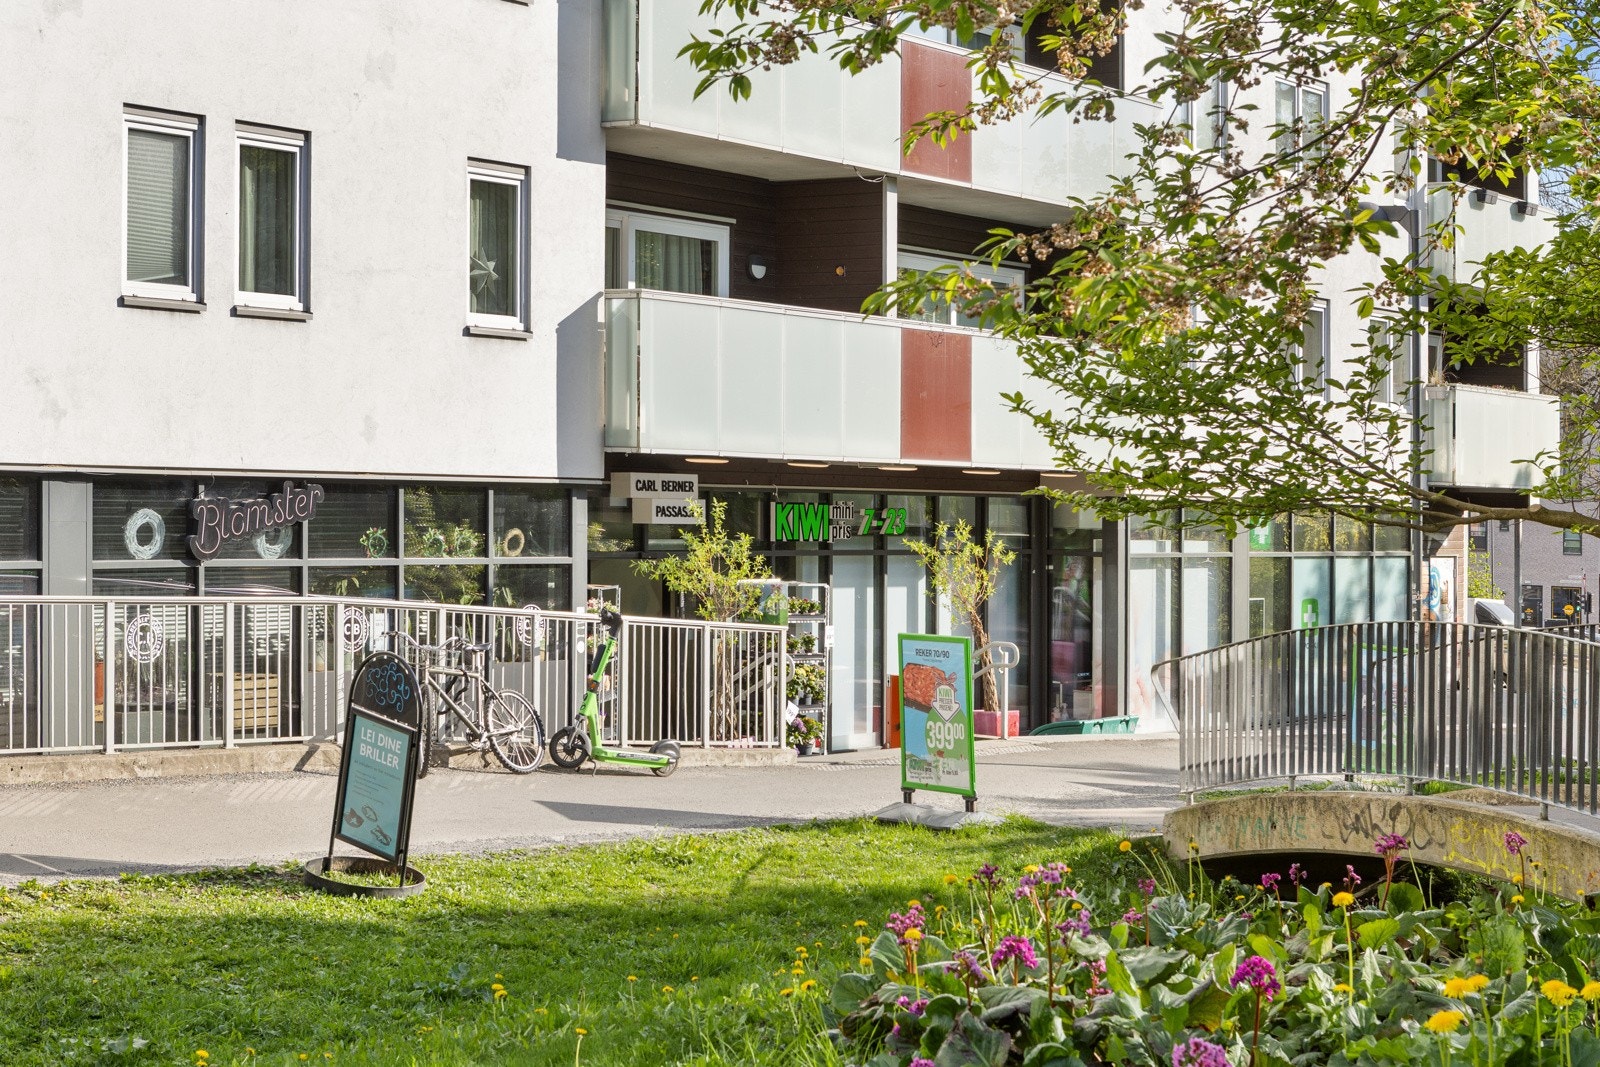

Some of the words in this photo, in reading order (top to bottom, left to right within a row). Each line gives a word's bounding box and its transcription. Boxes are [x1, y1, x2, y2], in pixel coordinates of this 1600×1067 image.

[635, 479, 658, 492] CARL
[661, 480, 694, 492] BERNER
[195, 485, 321, 554] Blomster
[775, 502, 829, 541] KIWI
[832, 500, 854, 519] mini
[861, 508, 907, 536] 7-23
[832, 521, 852, 542] pris
[915, 648, 932, 657] REKER
[933, 650, 950, 658] 70/90
[361, 727, 376, 743] LEI
[377, 733, 402, 754] DINE
[359, 743, 399, 770] BRILLER
